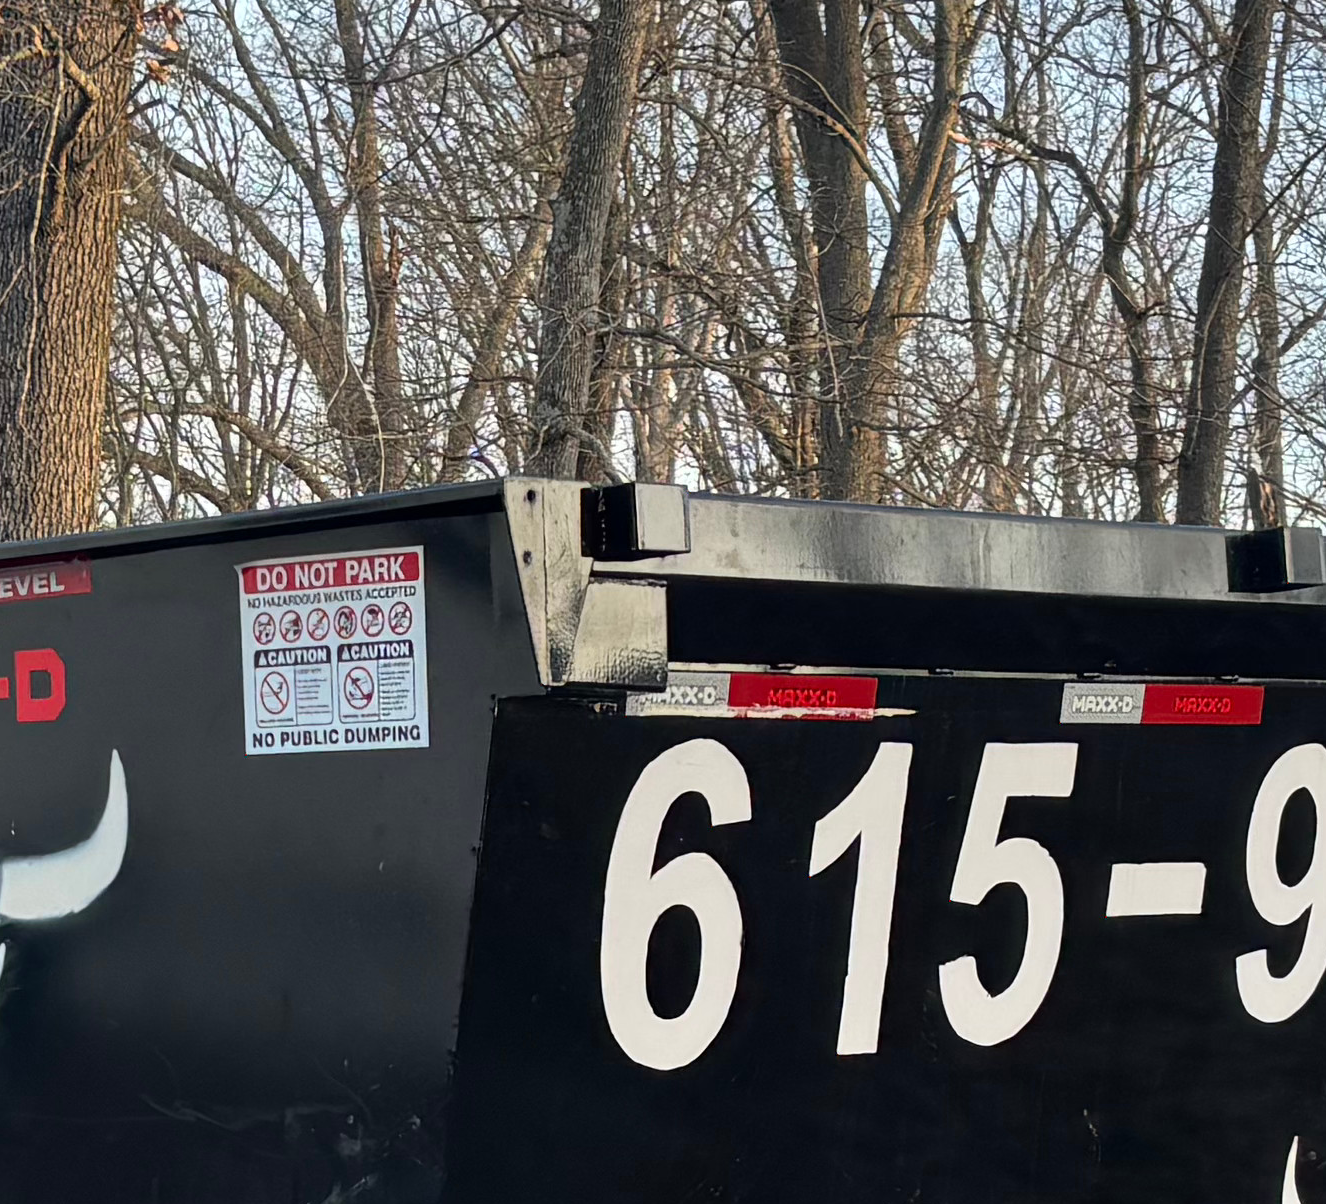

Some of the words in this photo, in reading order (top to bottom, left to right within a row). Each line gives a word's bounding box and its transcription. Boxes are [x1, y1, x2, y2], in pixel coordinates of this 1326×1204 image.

[256, 566, 288, 592] DO
[294, 561, 338, 589] NOT
[345, 555, 405, 584] PARK
[324, 588, 363, 604] WASTES
[365, 585, 417, 599] ACCEPTED
[267, 648, 327, 666] CAUTION
[350, 642, 410, 659] CAUTION
[252, 732, 275, 749] NO
[280, 729, 340, 747] PUBLIC
[344, 724, 421, 744] DUMPING
